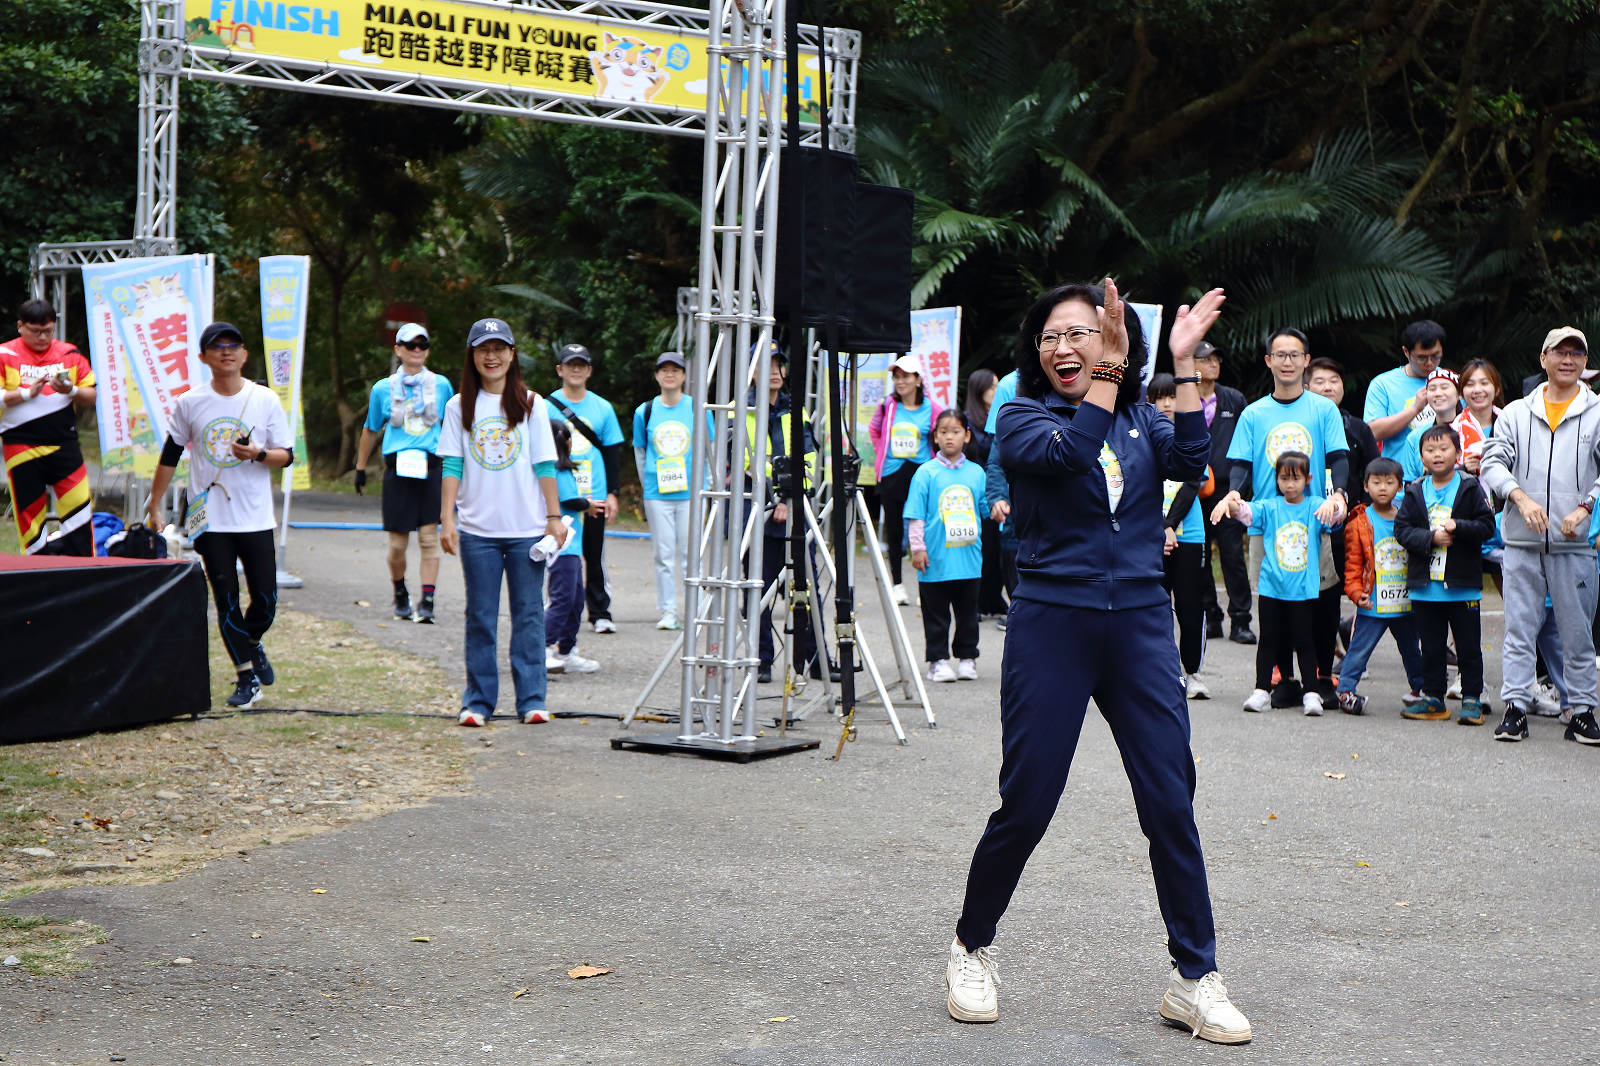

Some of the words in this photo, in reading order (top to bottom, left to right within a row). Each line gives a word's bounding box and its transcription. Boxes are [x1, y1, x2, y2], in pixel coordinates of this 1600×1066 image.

[210, 0, 340, 37] FINISH
[365, 3, 455, 32] MIAOLI
[464, 17, 510, 40] FUN
[518, 24, 598, 51] YOUNG
[363, 26, 594, 85] 跑酷越野障礙賽
[949, 528, 974, 537] 0318
[1381, 588, 1409, 600] 0572
